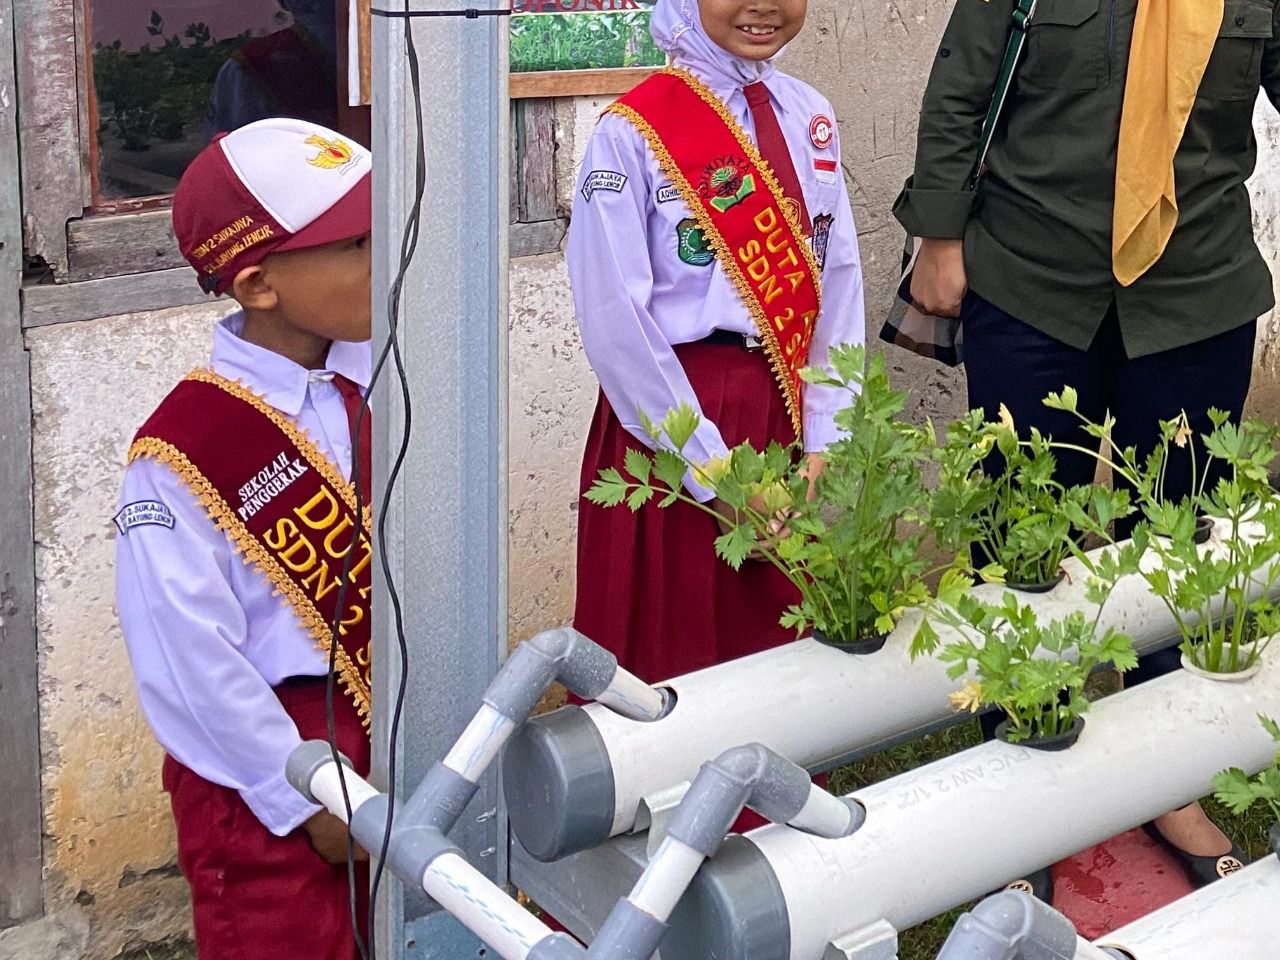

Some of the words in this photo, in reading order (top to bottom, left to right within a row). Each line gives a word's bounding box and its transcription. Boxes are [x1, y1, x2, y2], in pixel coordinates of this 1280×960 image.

[242, 224, 274, 249] LENCIR
[754, 206, 805, 295] DUTA
[738, 239, 784, 305] SDN
[774, 307, 794, 332] 2
[237, 458, 309, 523] PENGGERAK
[238, 451, 290, 503] SEKOLAH
[262, 517, 343, 602] SDN
[333, 605, 364, 636] 2
[950, 764, 985, 788] AW
[987, 748, 1032, 771] PVC
[932, 779, 950, 793] 2
